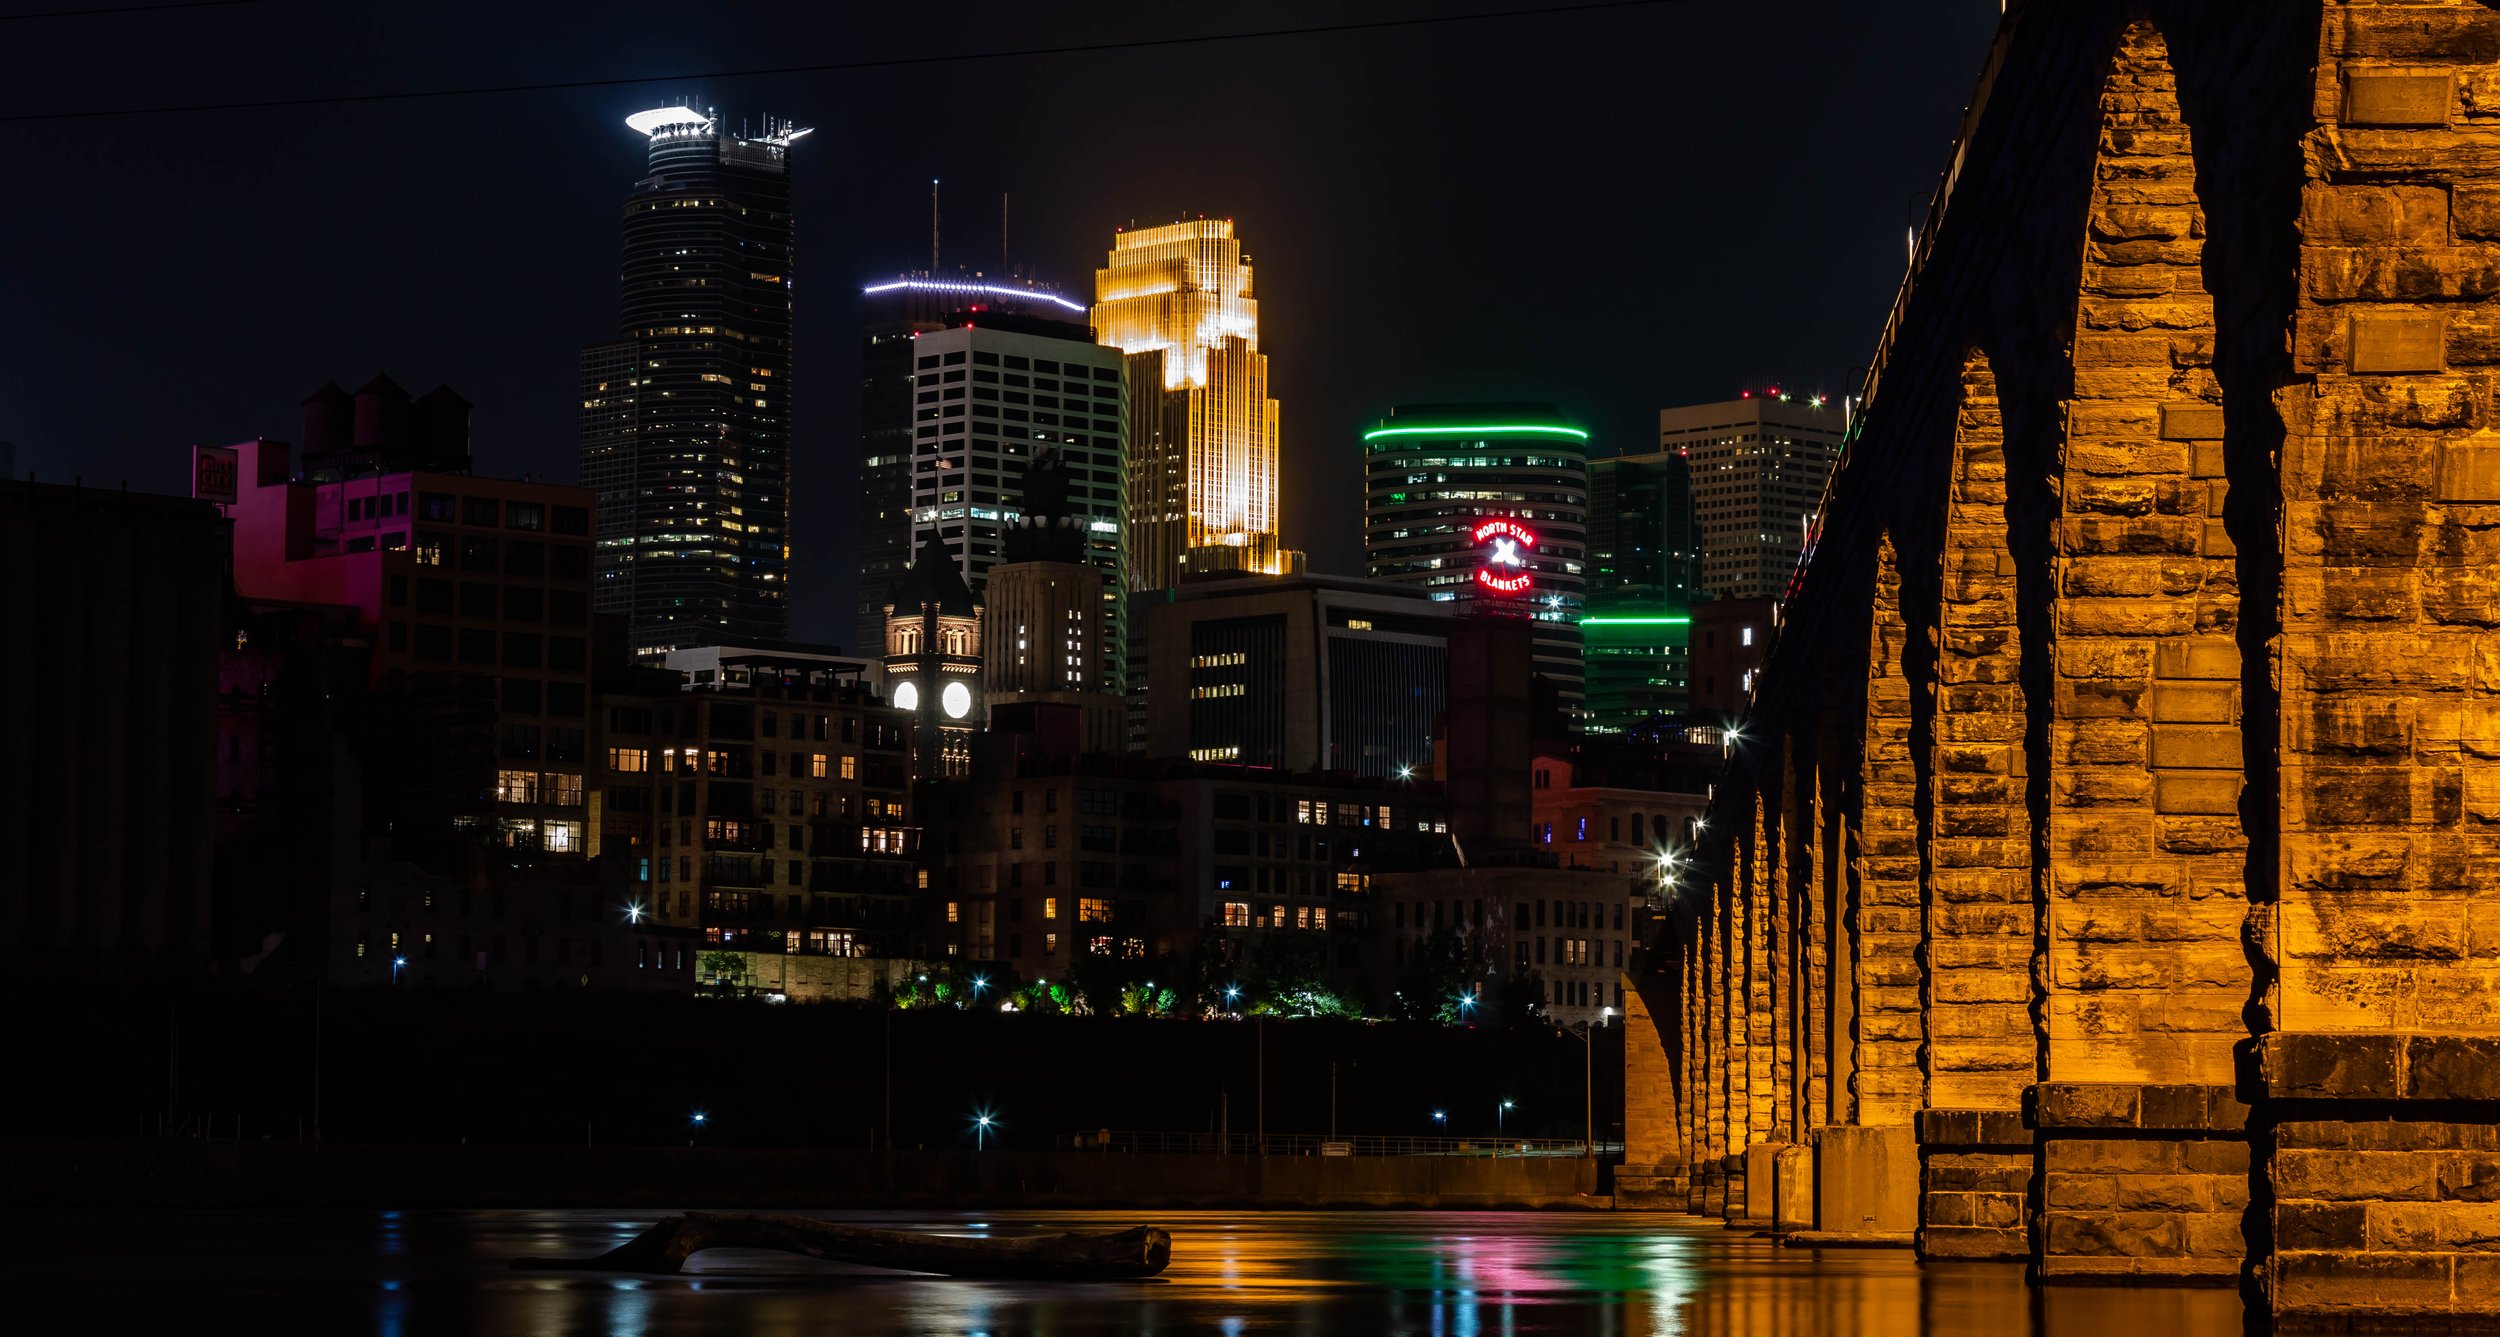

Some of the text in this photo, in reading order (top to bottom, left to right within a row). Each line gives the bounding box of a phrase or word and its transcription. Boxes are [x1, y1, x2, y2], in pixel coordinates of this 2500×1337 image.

[202, 472, 231, 488] CITY
[1476, 522, 1533, 546] NORTH STAR
[1480, 570, 1530, 591] BLANKETS
